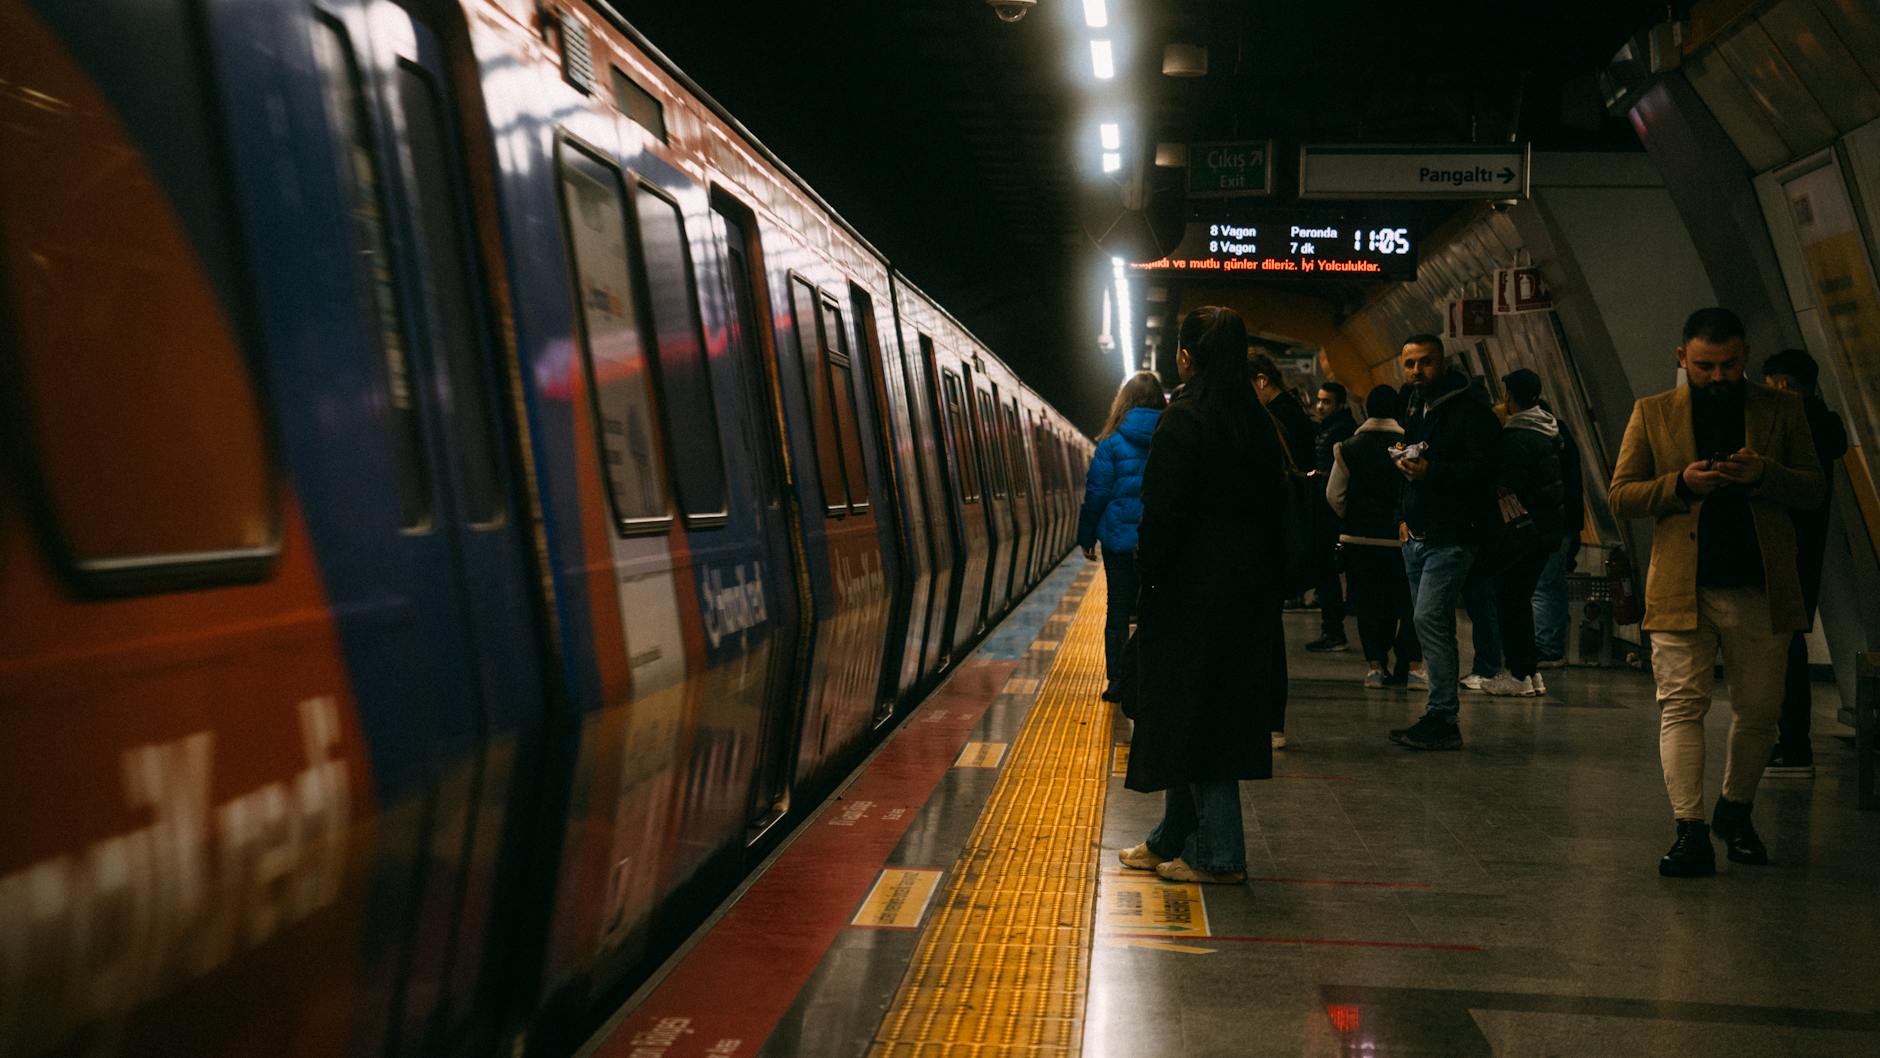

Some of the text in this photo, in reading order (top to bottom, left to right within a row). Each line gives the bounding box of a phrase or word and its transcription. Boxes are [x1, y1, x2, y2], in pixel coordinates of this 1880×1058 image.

[1220, 173, 1245, 189] Exit
[1420, 166, 1492, 186] Pangaltı
[1209, 224, 1338, 240] 8 Vagon Peronda
[1209, 240, 1315, 256] 8 Vagon 7 dk
[1354, 228, 1410, 254] 11:05
[1173, 260, 1186, 268] ve
[1189, 258, 1220, 269] mutlu
[1224, 258, 1258, 271] günler
[1261, 258, 1298, 270] dileriz.
[1301, 257, 1314, 272] İyi
[1317, 259, 1381, 272] Yolculuklar.
